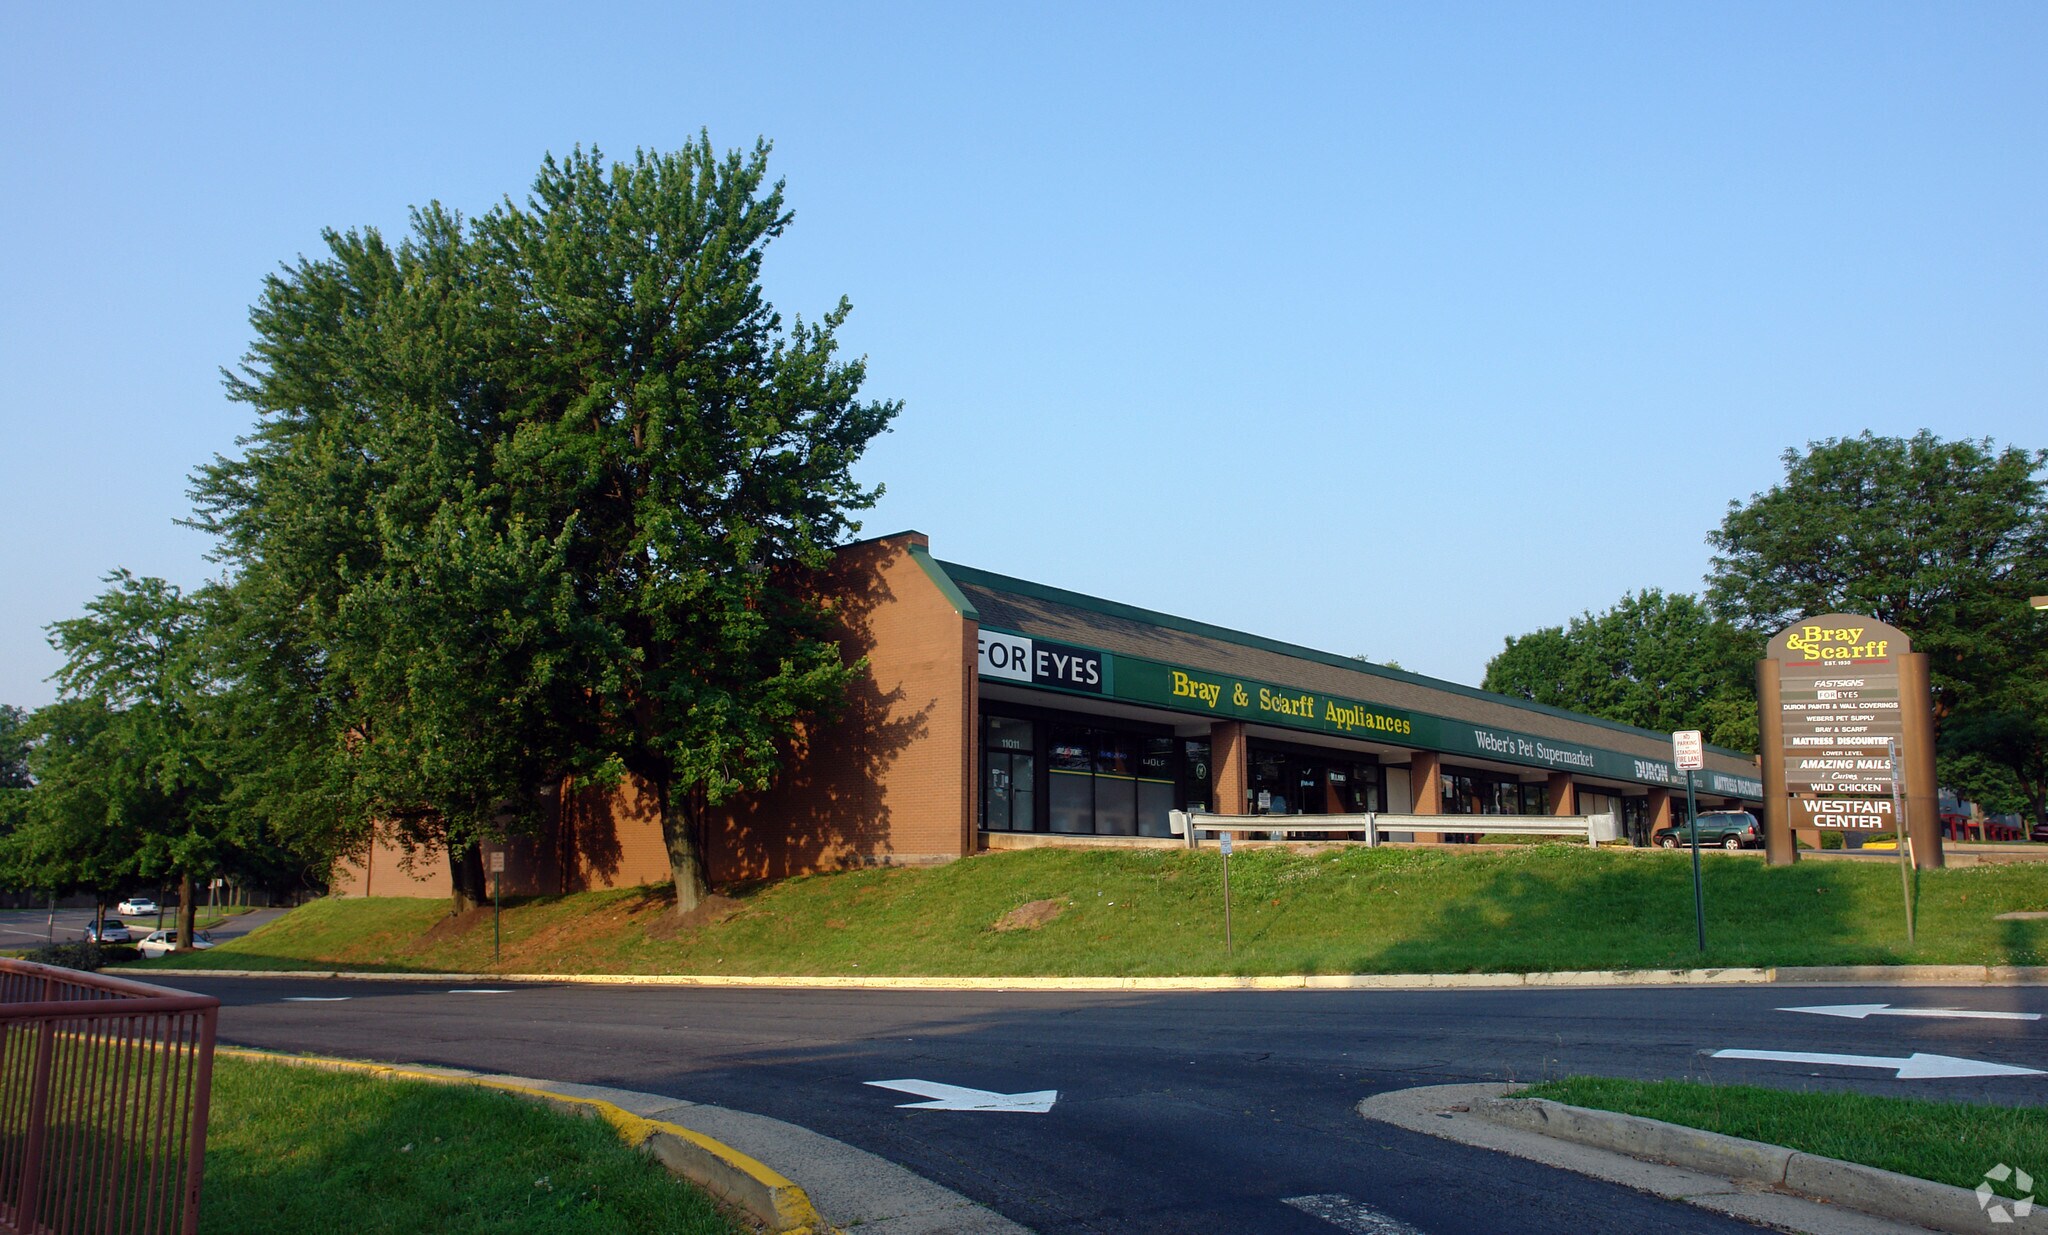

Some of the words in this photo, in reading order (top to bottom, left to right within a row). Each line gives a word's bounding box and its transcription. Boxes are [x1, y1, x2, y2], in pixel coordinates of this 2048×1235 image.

[1802, 625, 1864, 644] Bray
[1786, 633, 1808, 650] &
[1804, 640, 1888, 660] Scarff
[1036, 650, 1099, 685] EYES
[1814, 679, 1865, 688] FASTSIGNS
[1172, 671, 1221, 709] Bray
[1232, 682, 1249, 707] &
[1259, 687, 1315, 719] Scarff
[1325, 700, 1412, 735] Appliances
[1001, 739, 1020, 749] 11011
[1792, 737, 1834, 745] MATTRESS
[1837, 736, 1894, 745] DISCOUNTER
[1475, 731, 1516, 754] Weber's
[1518, 739, 1534, 757] Pet
[1536, 743, 1594, 767] Supermarket
[1635, 760, 1669, 782] DURON
[1800, 760, 1854, 769] AMAZING
[1856, 759, 1891, 769] NAILS
[1831, 772, 1858, 781] Curves
[1811, 783, 1834, 791] WILD
[1838, 783, 1882, 792] CHICKEN
[1803, 800, 1892, 814] WESTFAIR
[1813, 814, 1883, 829] CENTER
